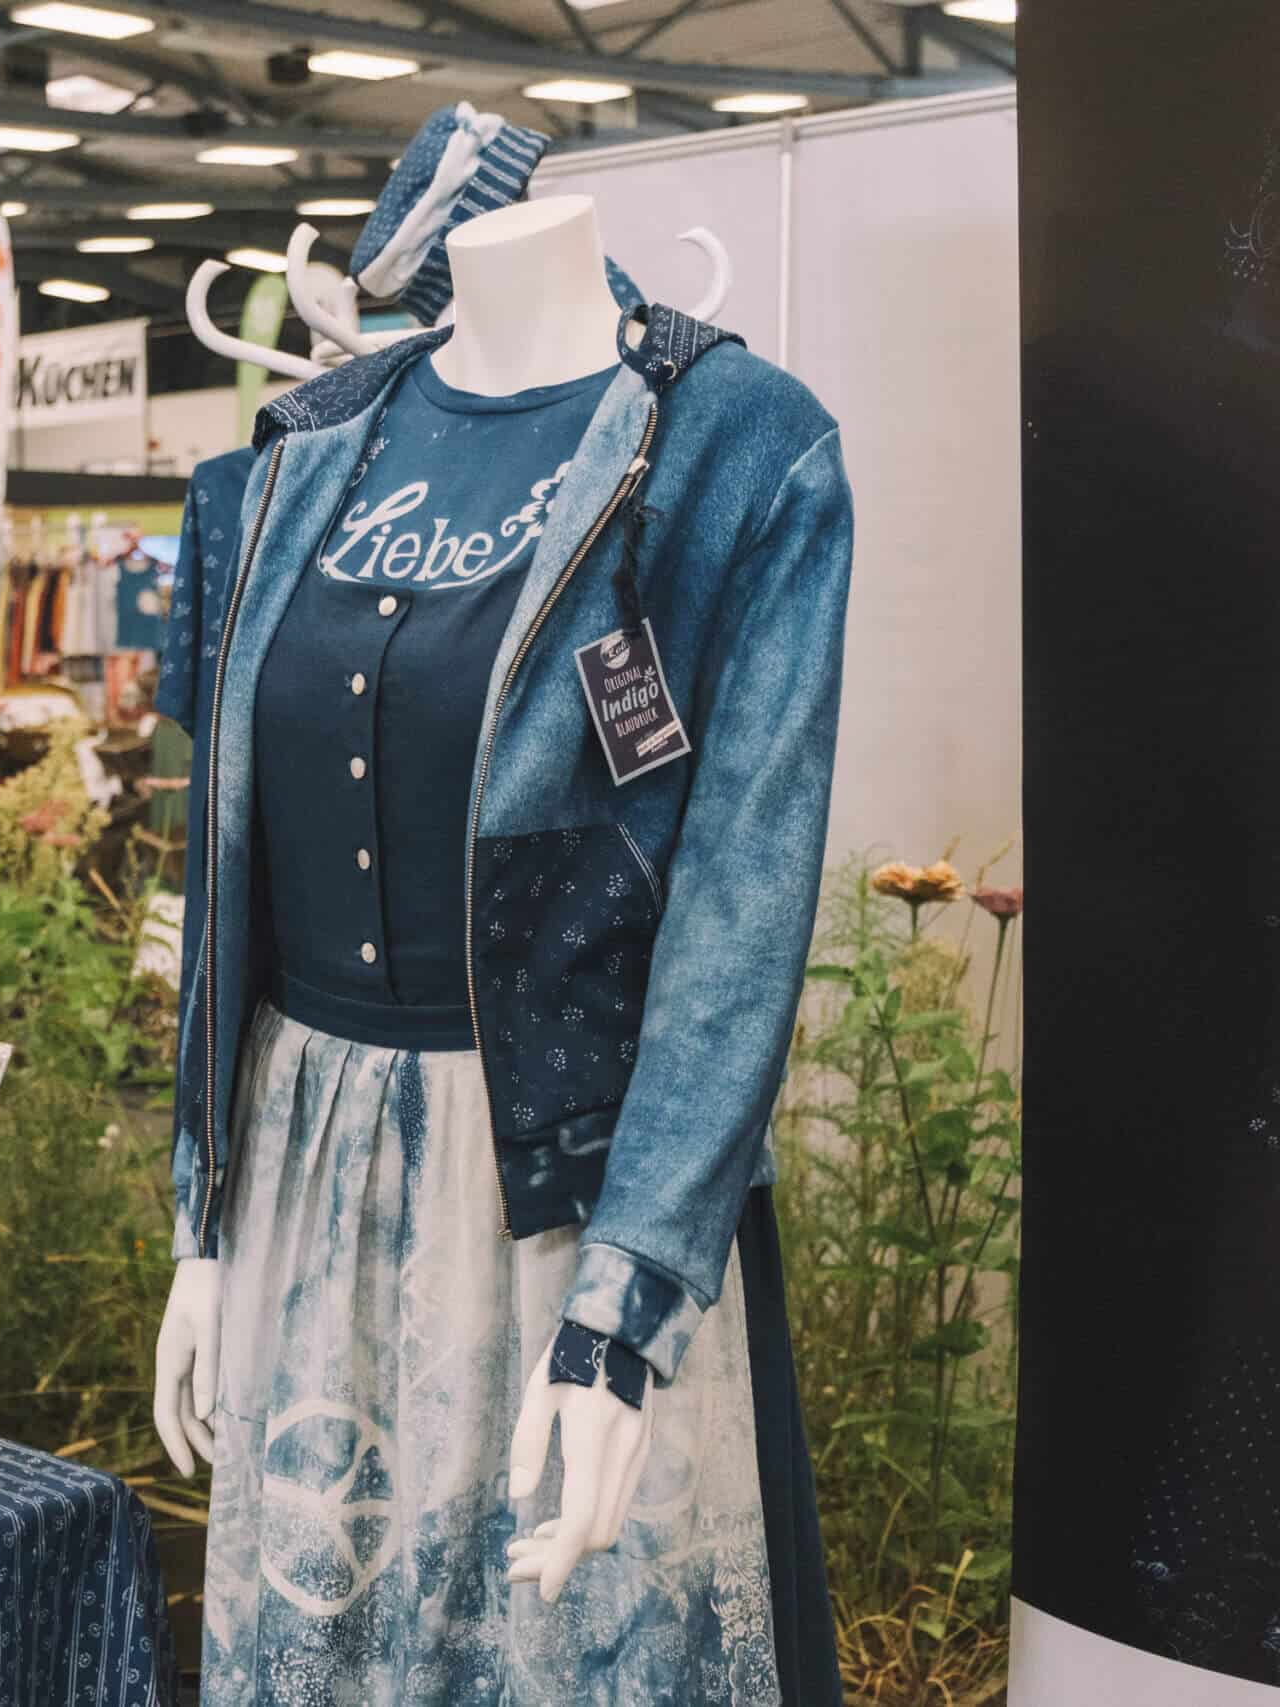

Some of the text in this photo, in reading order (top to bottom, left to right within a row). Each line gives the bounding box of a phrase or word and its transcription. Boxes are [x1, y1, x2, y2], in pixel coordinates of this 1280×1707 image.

[317, 480, 494, 584] Liebe
[604, 665, 642, 693] ORIGINAL
[601, 681, 659, 722] Indigo
